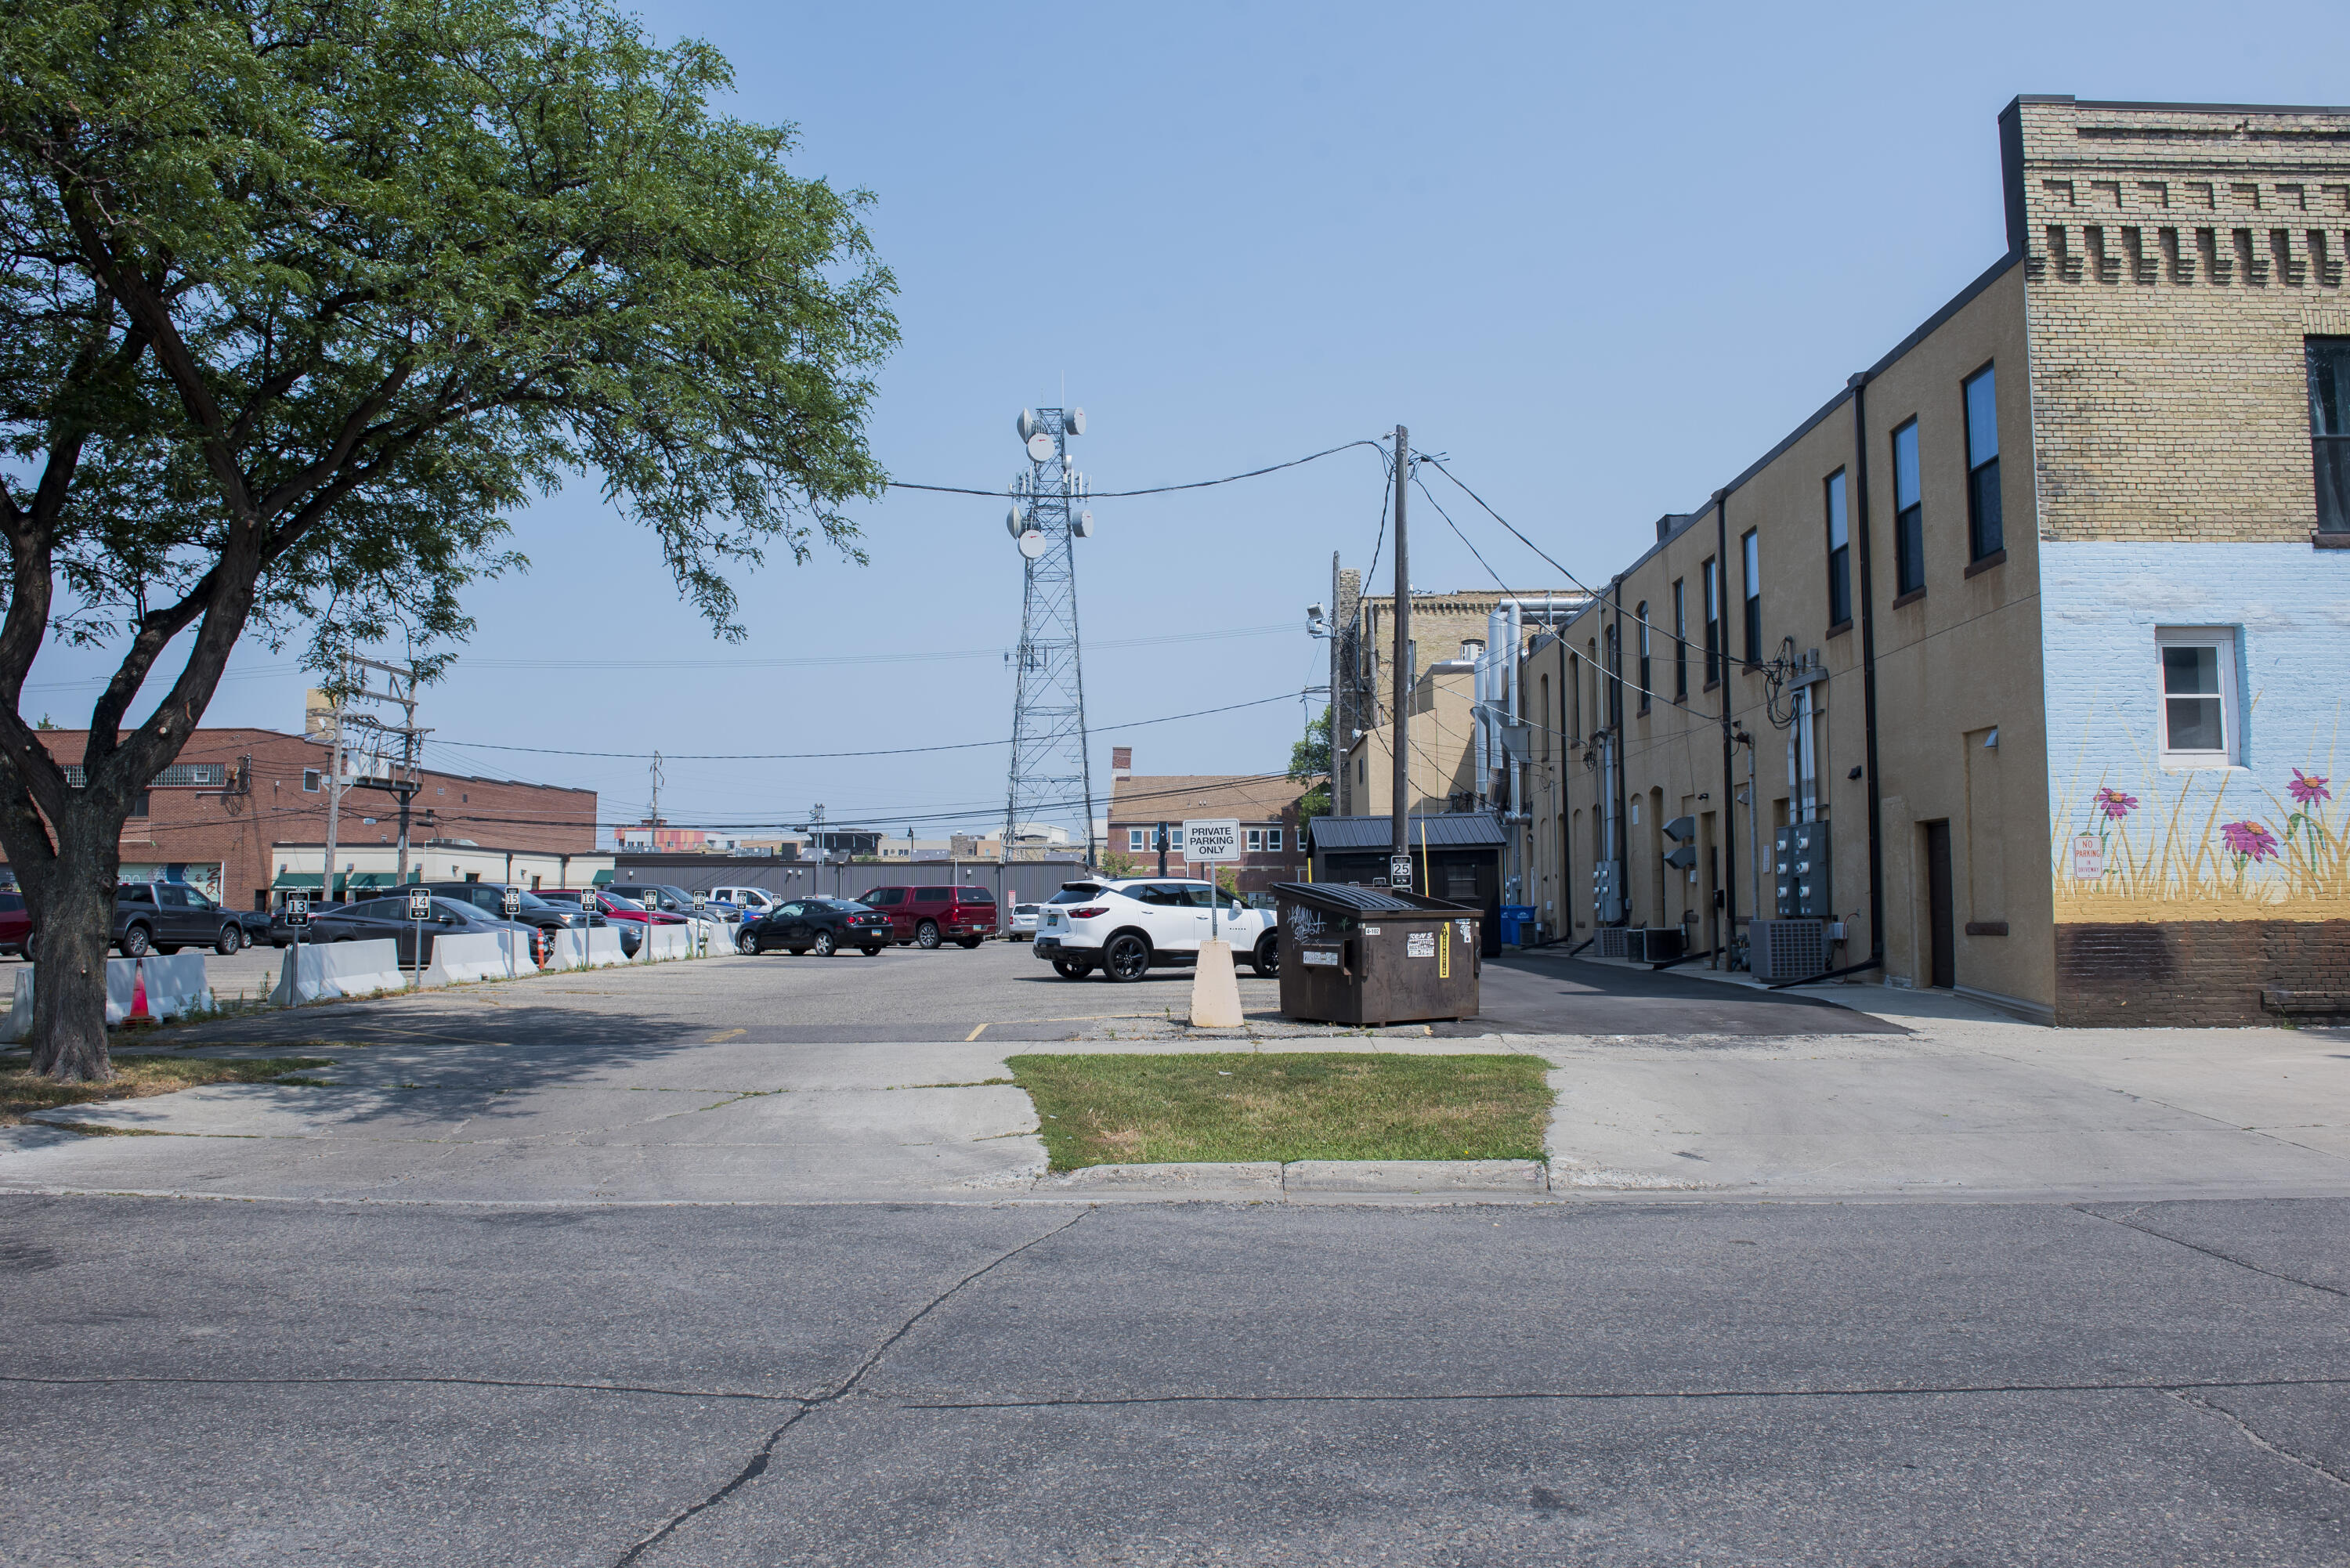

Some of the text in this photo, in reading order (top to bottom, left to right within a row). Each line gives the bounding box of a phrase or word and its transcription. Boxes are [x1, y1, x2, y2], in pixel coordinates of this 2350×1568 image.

[1191, 827, 1231, 836] PRIVATE
[1190, 836, 1234, 845] PARKING
[1198, 846, 1225, 854] ONLY
[1394, 864, 1409, 874] 25
[413, 897, 428, 907] 14
[508, 894, 518, 903] 15
[584, 894, 595, 903] 16
[290, 901, 306, 912] 13
